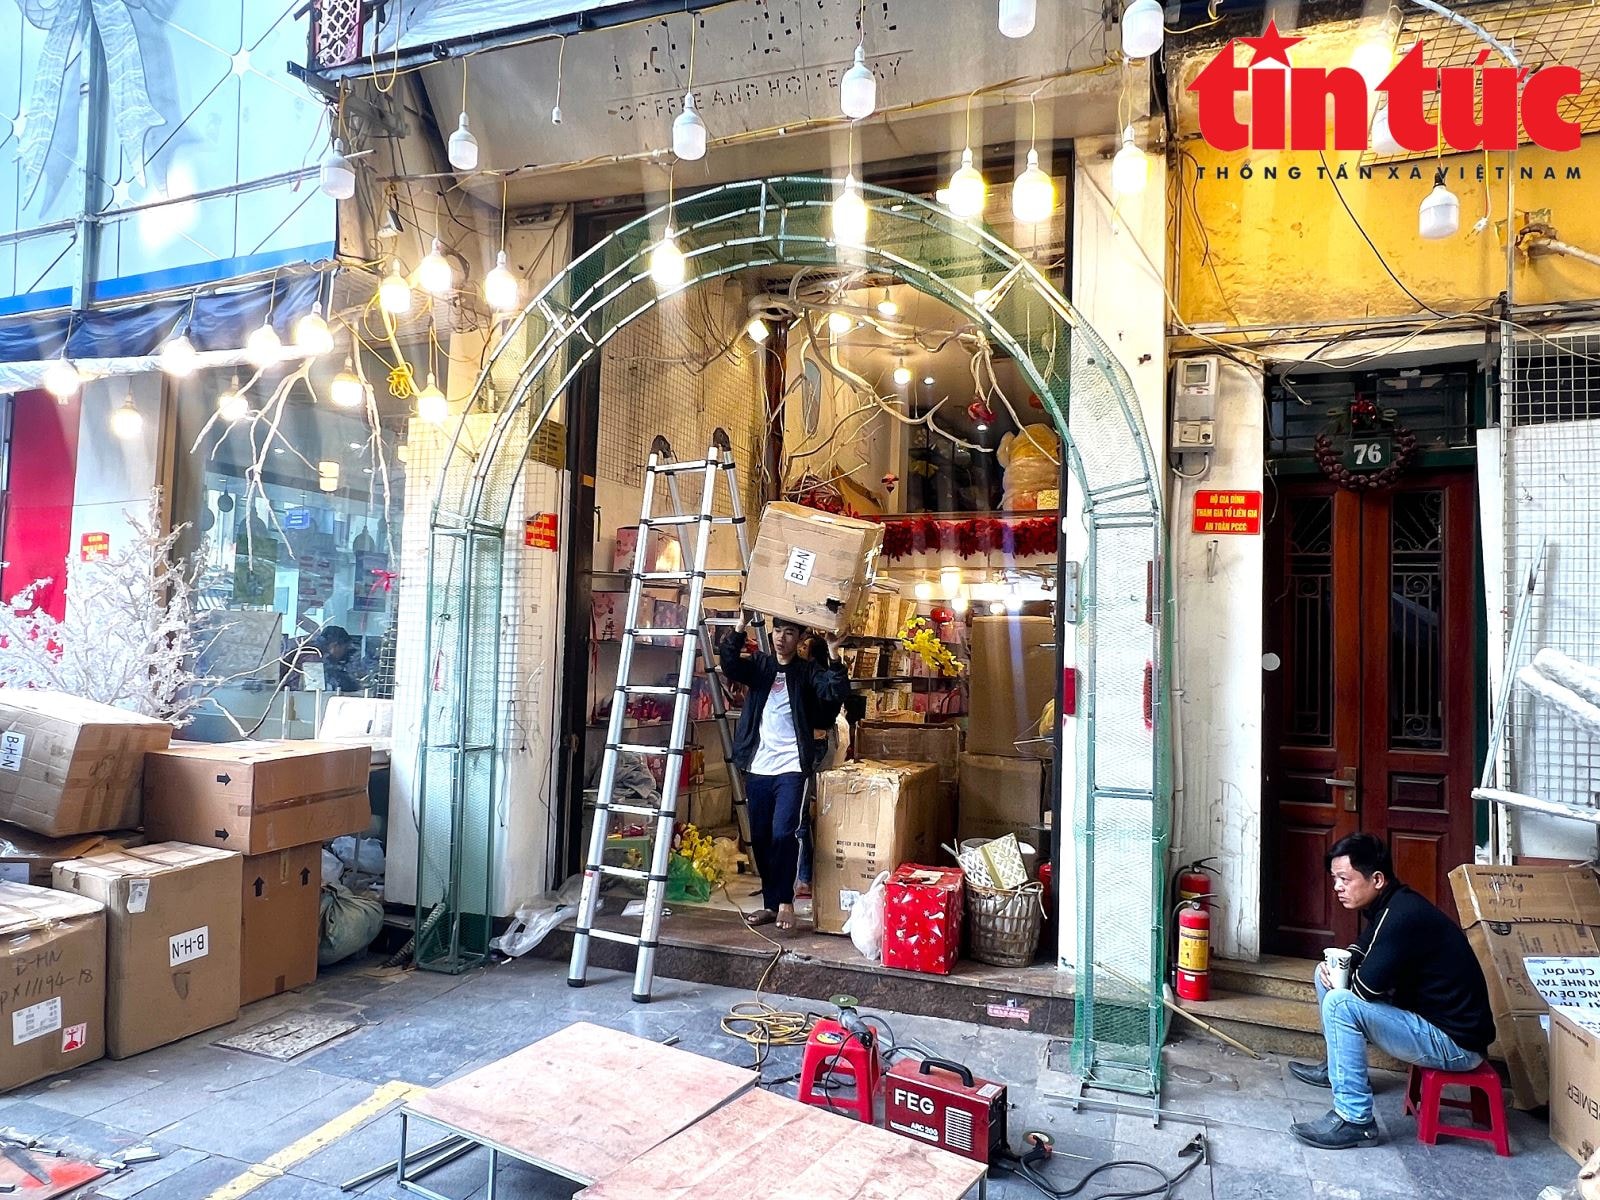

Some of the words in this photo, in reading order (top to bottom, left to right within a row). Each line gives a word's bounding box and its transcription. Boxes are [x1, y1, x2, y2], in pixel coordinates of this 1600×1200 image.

[1353, 443, 1382, 465] 76
[791, 550, 811, 582] B-H-N
[2, 735, 20, 769] B-H-N
[172, 934, 205, 960] B-H-N
[1536, 979, 1559, 987] TAY
[894, 1088, 935, 1115] FEG
[1568, 1081, 1600, 1121] EMIER
